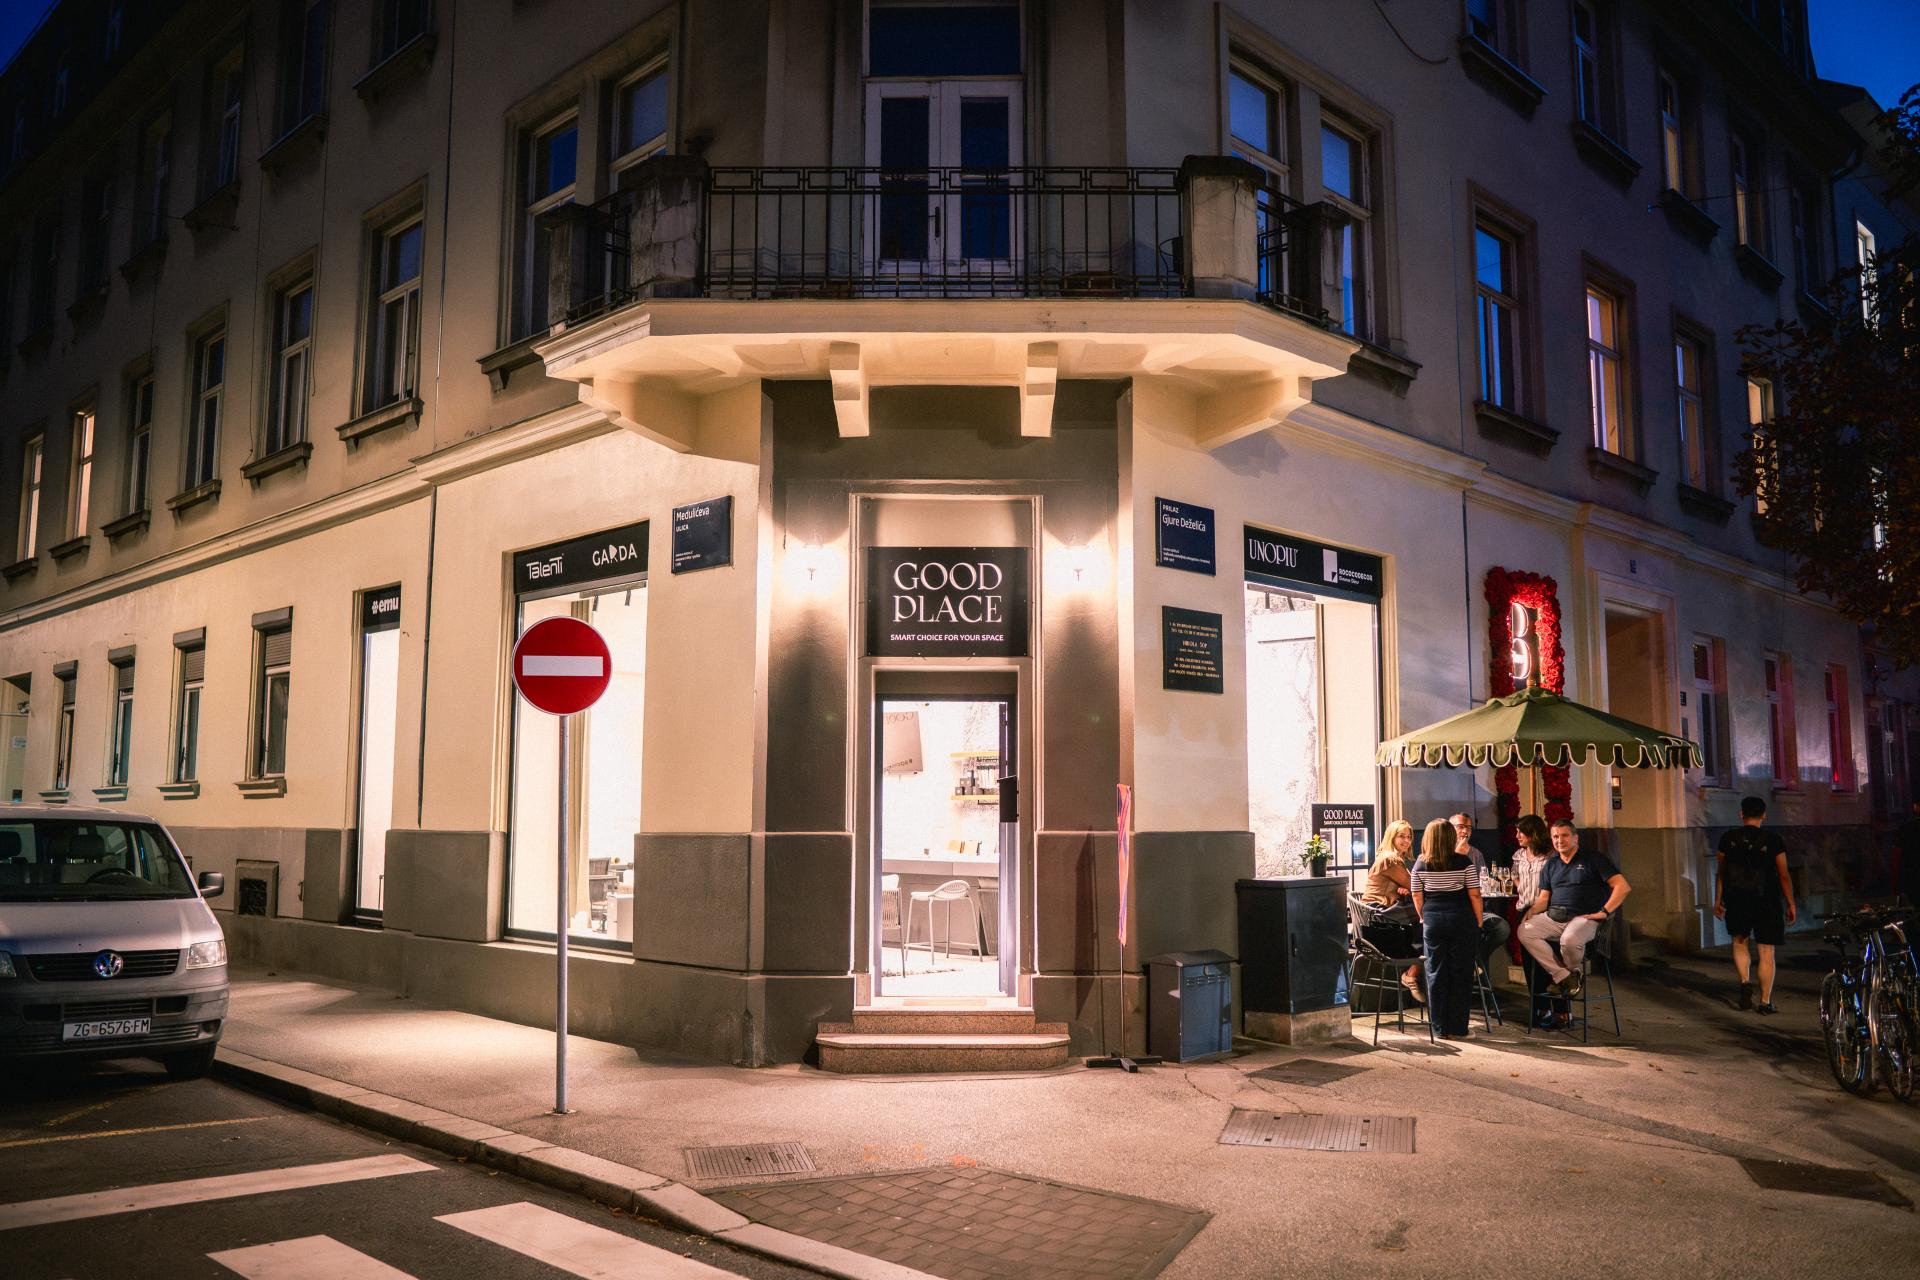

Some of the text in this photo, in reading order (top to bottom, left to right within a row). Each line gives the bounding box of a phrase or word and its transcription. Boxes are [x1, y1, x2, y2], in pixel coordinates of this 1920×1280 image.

[676, 506, 710, 522] Medulićeva
[1162, 504, 1179, 514] PRILAZ
[675, 524, 689, 533] ULICA
[1162, 514, 1206, 532] Gjure Deželića
[592, 543, 638, 566] GARDA
[893, 562, 1003, 591] GOOD
[378, 597, 399, 613] emu
[893, 595, 1002, 623] PLACE
[1323, 810, 1364, 820] GOOD PLACE
[73, 1023, 90, 1037] ZG
